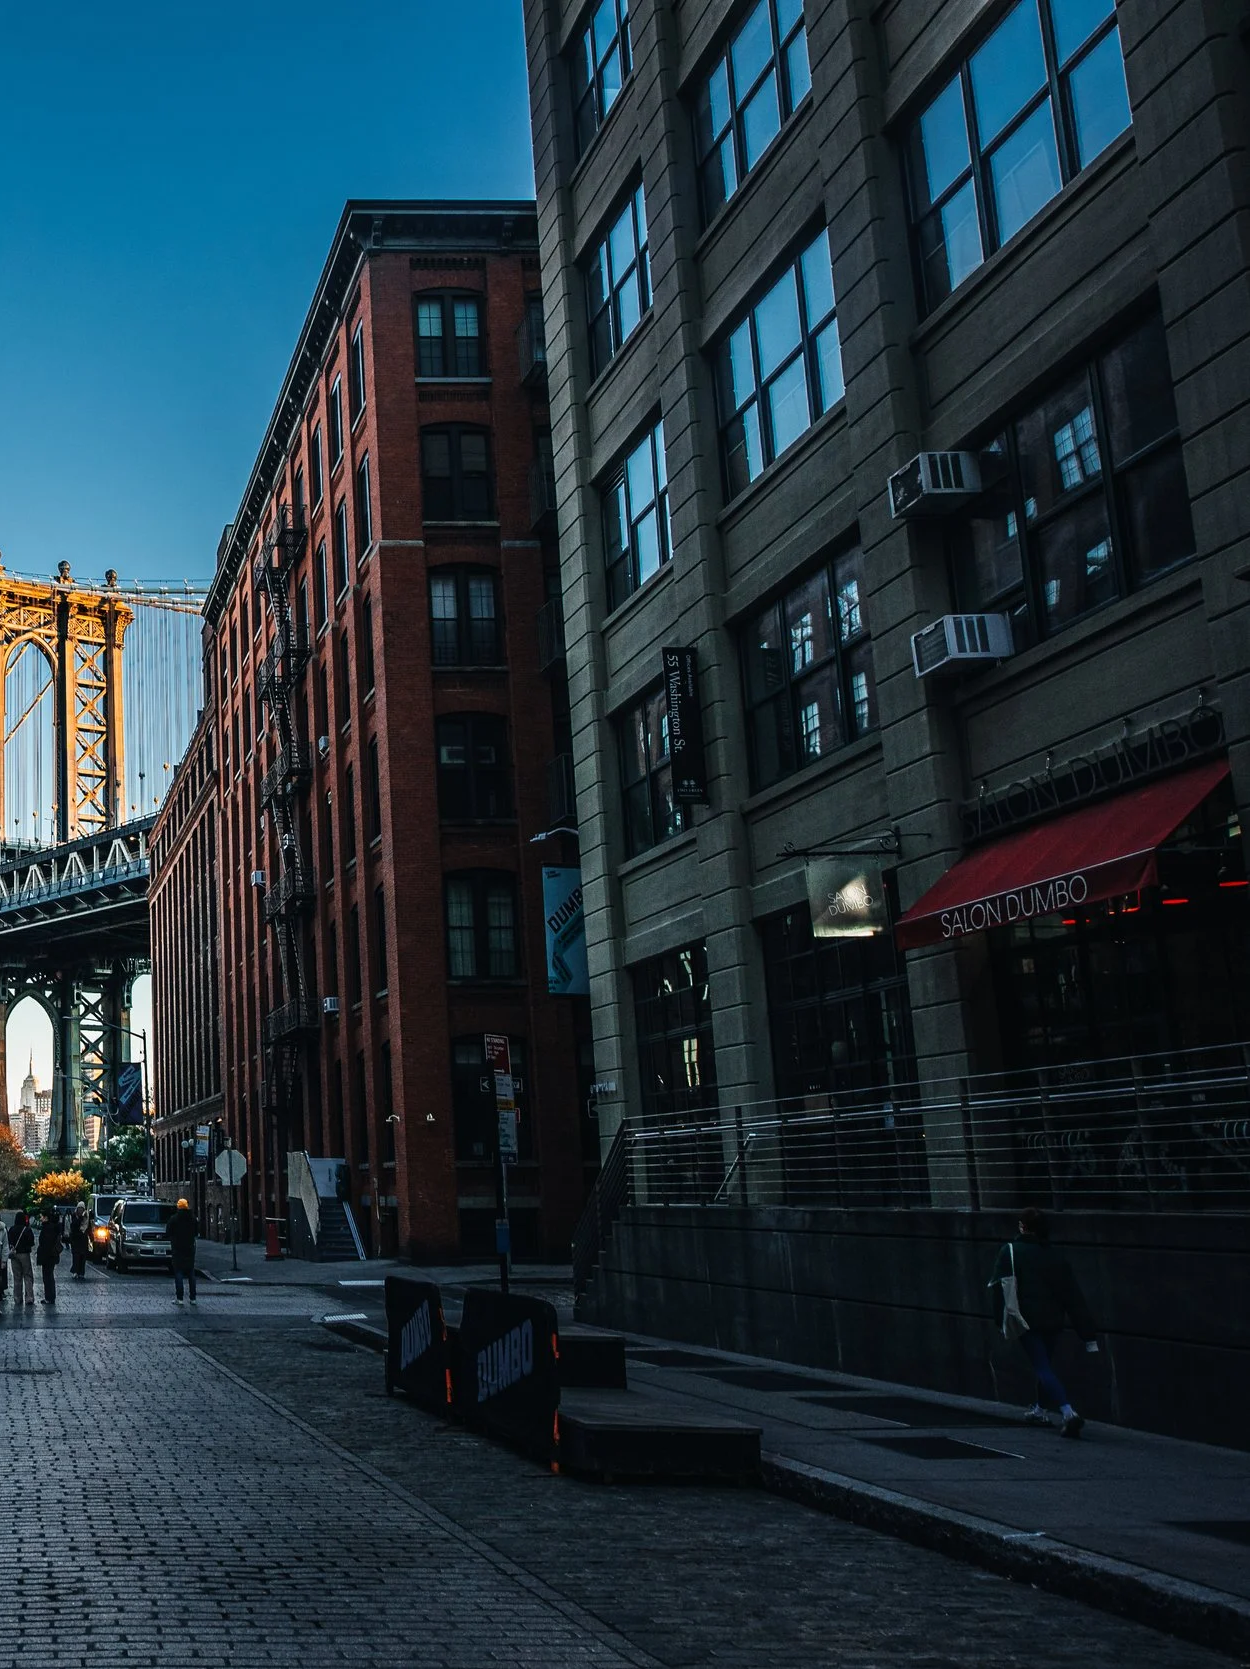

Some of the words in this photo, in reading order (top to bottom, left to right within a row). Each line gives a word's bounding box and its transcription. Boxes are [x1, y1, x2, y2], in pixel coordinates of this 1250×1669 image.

[666, 654, 679, 667] 55
[668, 671, 683, 736] Washington
[673, 738, 686, 753] St.
[958, 770, 1060, 839] SALON
[1068, 705, 1224, 799] DUMBO
[828, 885, 867, 904] SALON
[829, 896, 873, 916] DUMBO
[940, 899, 1001, 938] SALON
[1006, 874, 1088, 921] DUMBO
[401, 1299, 431, 1372] DUMBO
[477, 1318, 534, 1402] DUMBO
